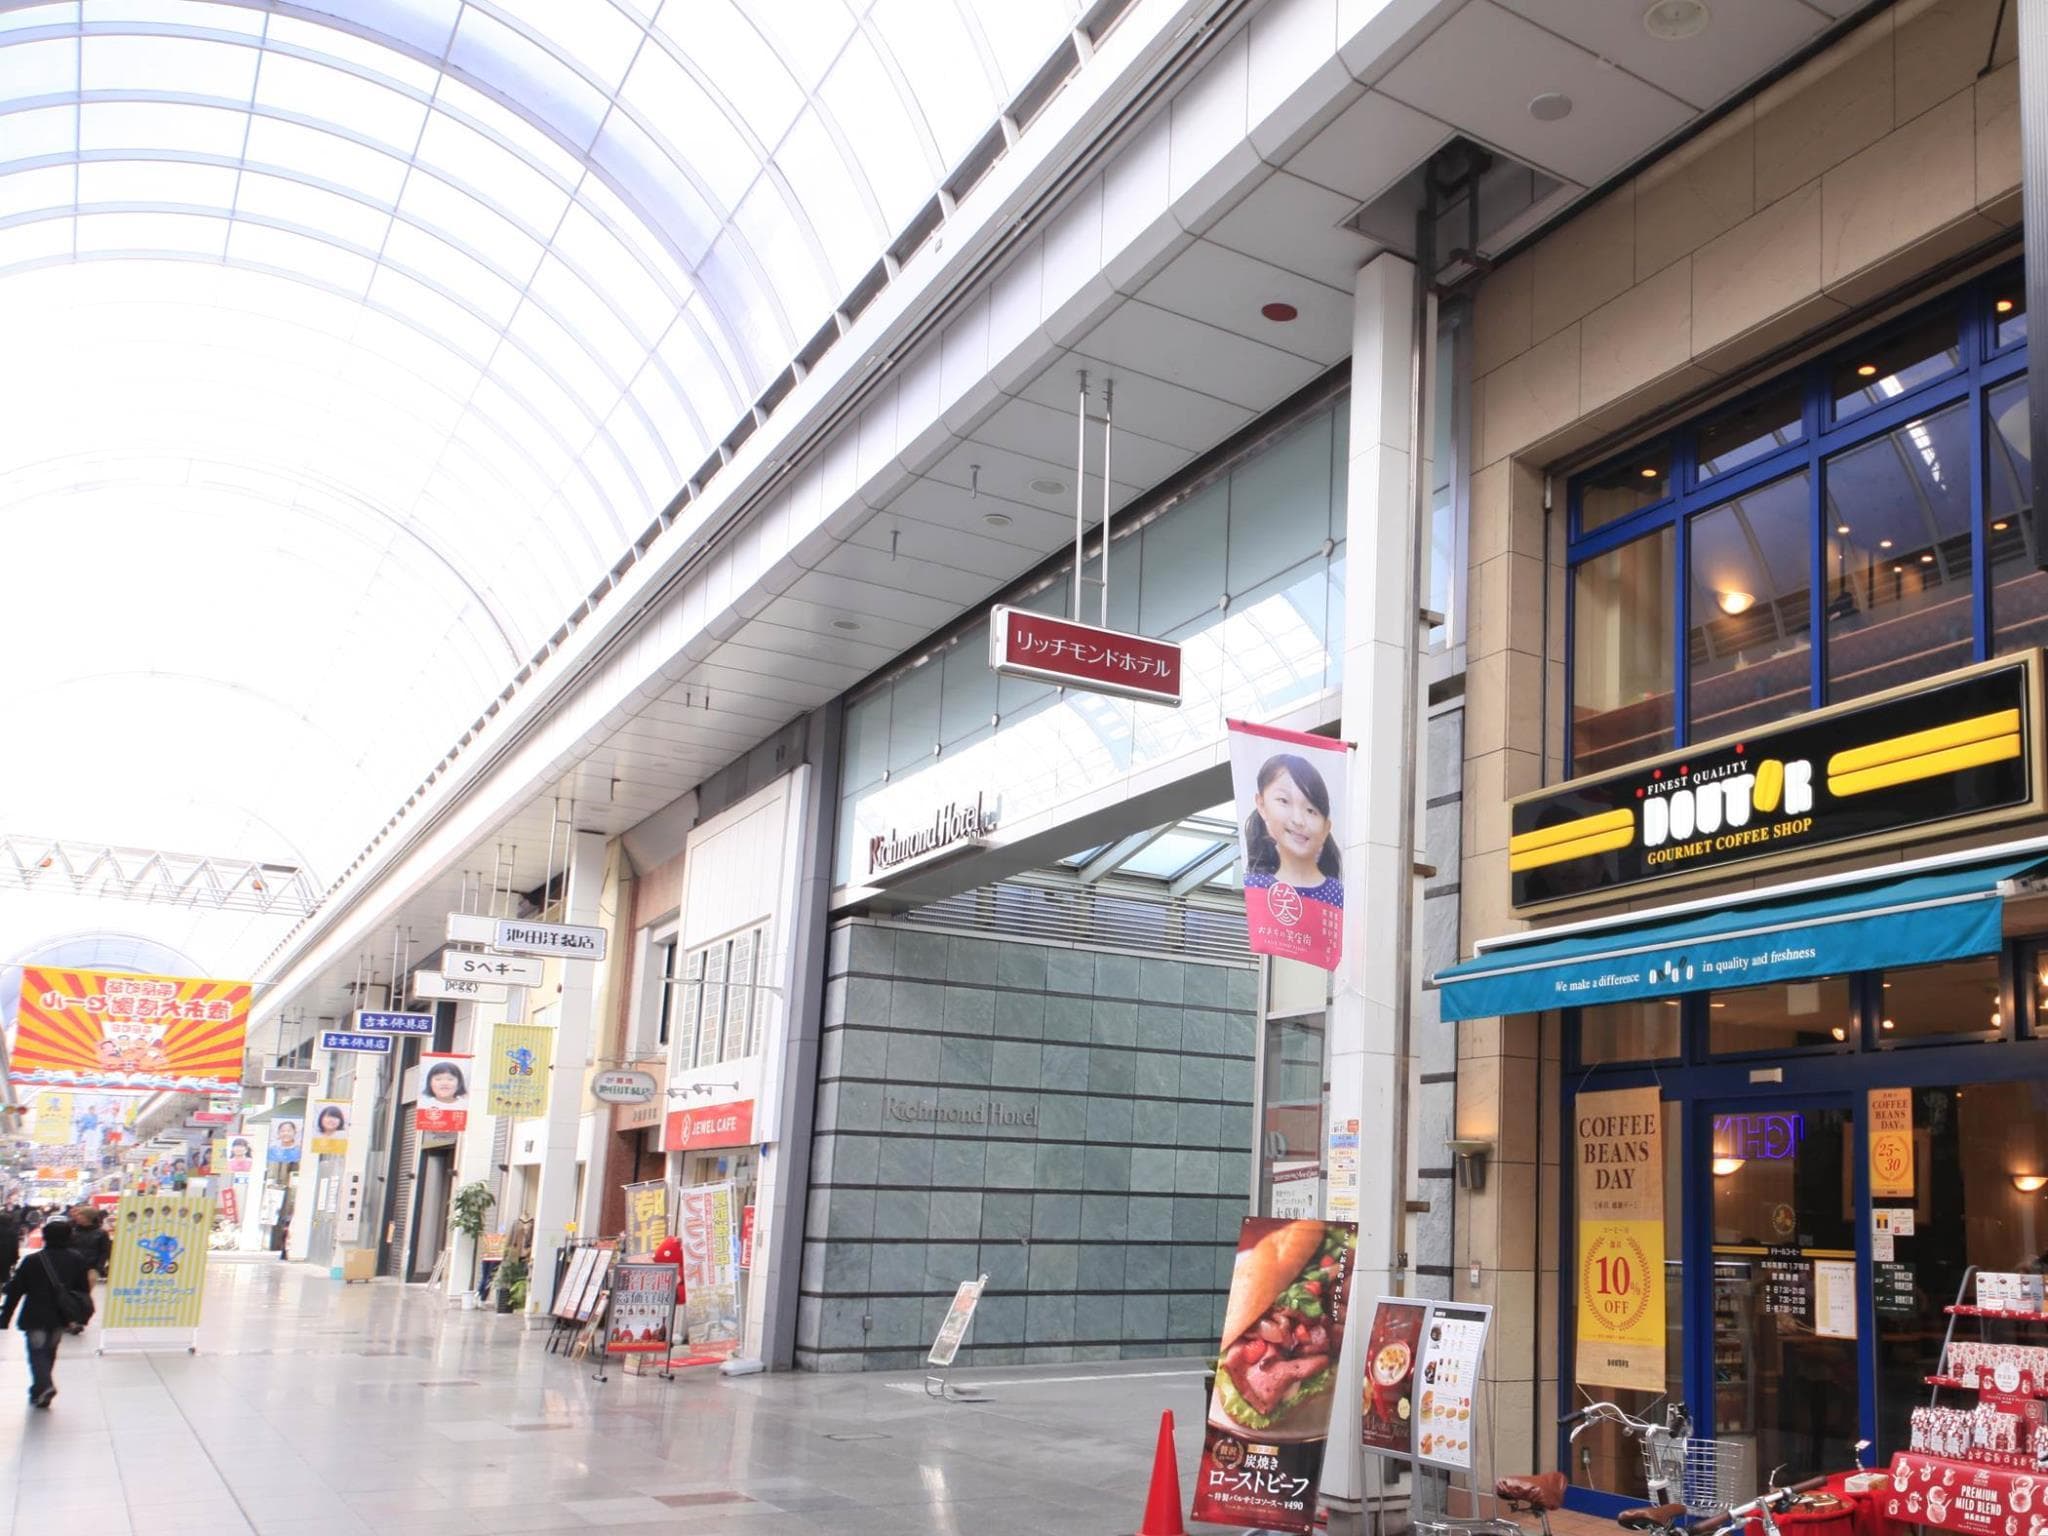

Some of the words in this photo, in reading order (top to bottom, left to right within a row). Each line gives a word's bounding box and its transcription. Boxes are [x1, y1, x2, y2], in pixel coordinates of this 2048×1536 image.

[1017, 630, 1171, 678] リッチモンドホテル
[1647, 776, 1689, 796] FINEST
[1693, 760, 1748, 785] QUALITY
[1643, 759, 1813, 847] DOUTOR
[869, 810, 940, 875] Richmond
[939, 791, 983, 847] Hotel
[1647, 840, 1713, 865] GOURMET
[1715, 827, 1770, 850] COFFEE
[1773, 817, 1813, 839] SHOP
[1271, 885, 1299, 921] 笑
[506, 928, 595, 949] 池田洋装店
[1702, 961, 1713, 972] in
[1716, 956, 1749, 974] quality
[1752, 953, 1768, 966] and
[1771, 948, 1816, 963] freshness
[1555, 981, 1568, 992] We
[1569, 979, 1591, 991] make
[1599, 974, 1640, 987] difference
[885, 1098, 986, 1124] Richmond
[988, 1103, 1039, 1127] Hotel
[1872, 1100, 1908, 1110] COFFEE
[1875, 1109, 1906, 1119] BEANS
[692, 1120, 716, 1136] JEWEL
[716, 1116, 737, 1132] CAFE
[1579, 1114, 1656, 1138] COFFEE
[1880, 1120, 1900, 1130] DAY
[1584, 1141, 1649, 1164] BEANS
[1885, 1159, 1901, 1171] 30
[1595, 1168, 1636, 1190] DAY
[1604, 1300, 1629, 1314] OFF
[1244, 1454, 1279, 1471] 炭焼き
[1209, 1470, 1310, 1498] ローストビーフ
[1961, 1485, 1998, 1502] PREMIUM
[1284, 1501, 1304, 1511] ¥490
[1955, 1497, 1975, 1511] MILD
[1977, 1501, 2002, 1516] BLEND
